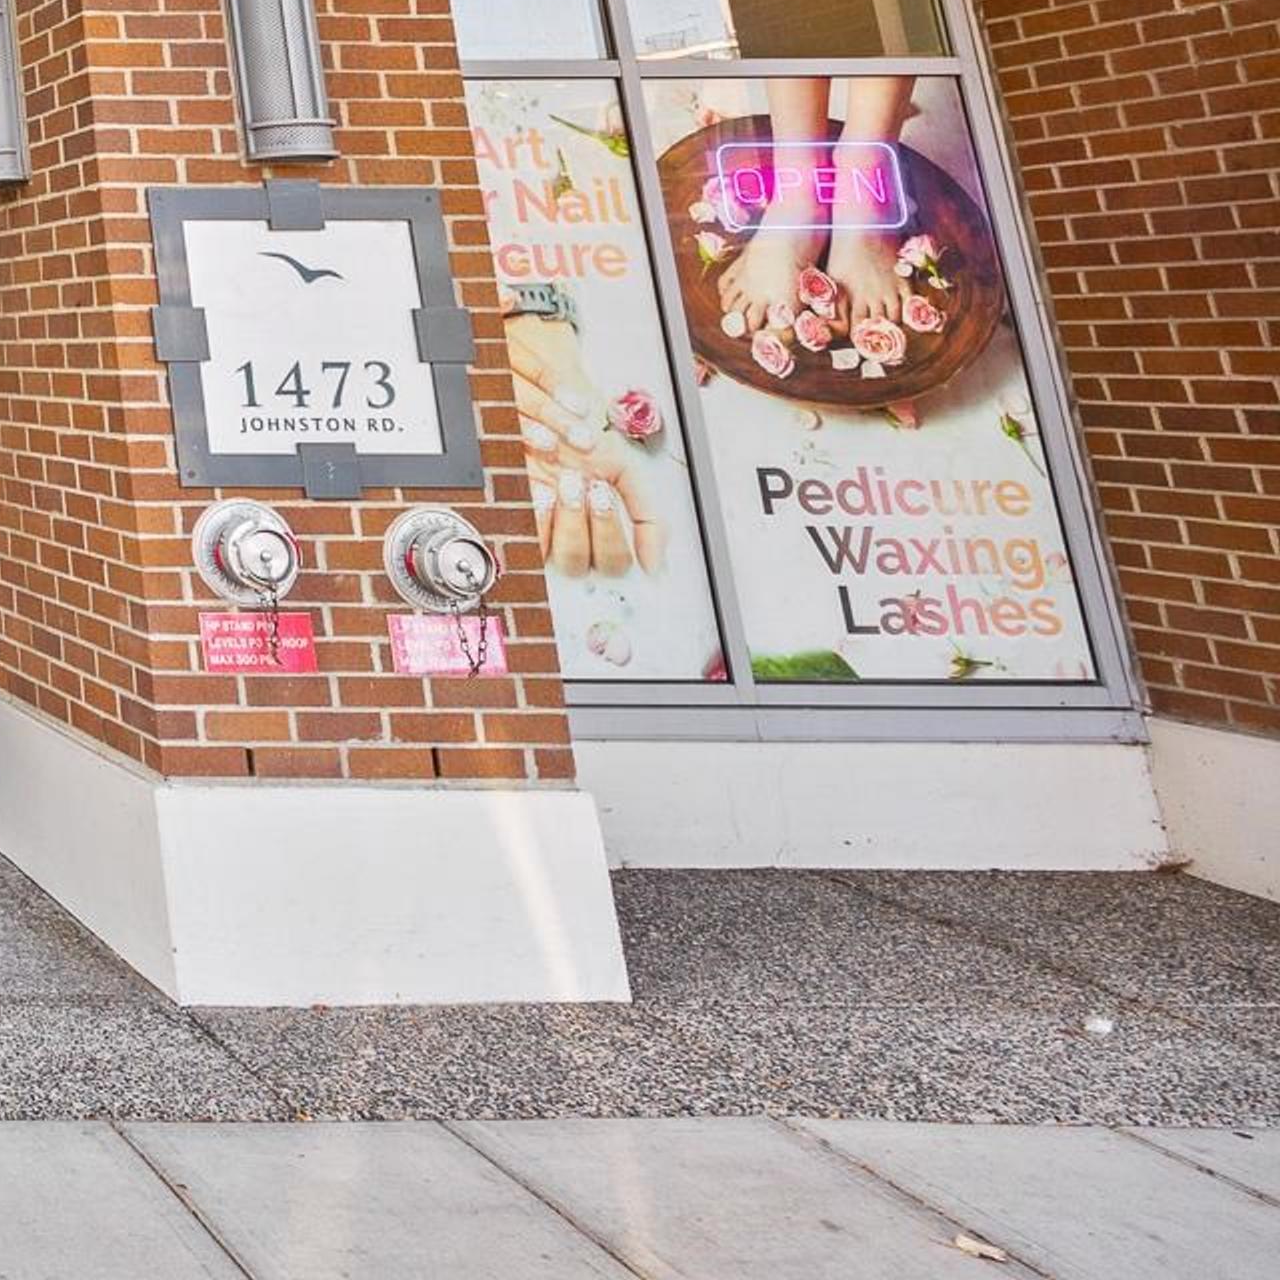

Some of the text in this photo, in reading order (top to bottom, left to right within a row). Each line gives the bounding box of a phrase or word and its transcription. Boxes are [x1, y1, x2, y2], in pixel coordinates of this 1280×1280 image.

[473, 126, 551, 170] Art
[512, 176, 632, 224] Nail
[733, 167, 888, 204] OPEN
[497, 242, 628, 278] cure
[235, 360, 396, 409] 1473
[240, 417, 405, 433] JOHNSTON RD.
[756, 466, 1032, 517] Pedicure
[805, 525, 1046, 591] Waxing
[837, 584, 1065, 637] Lashes
